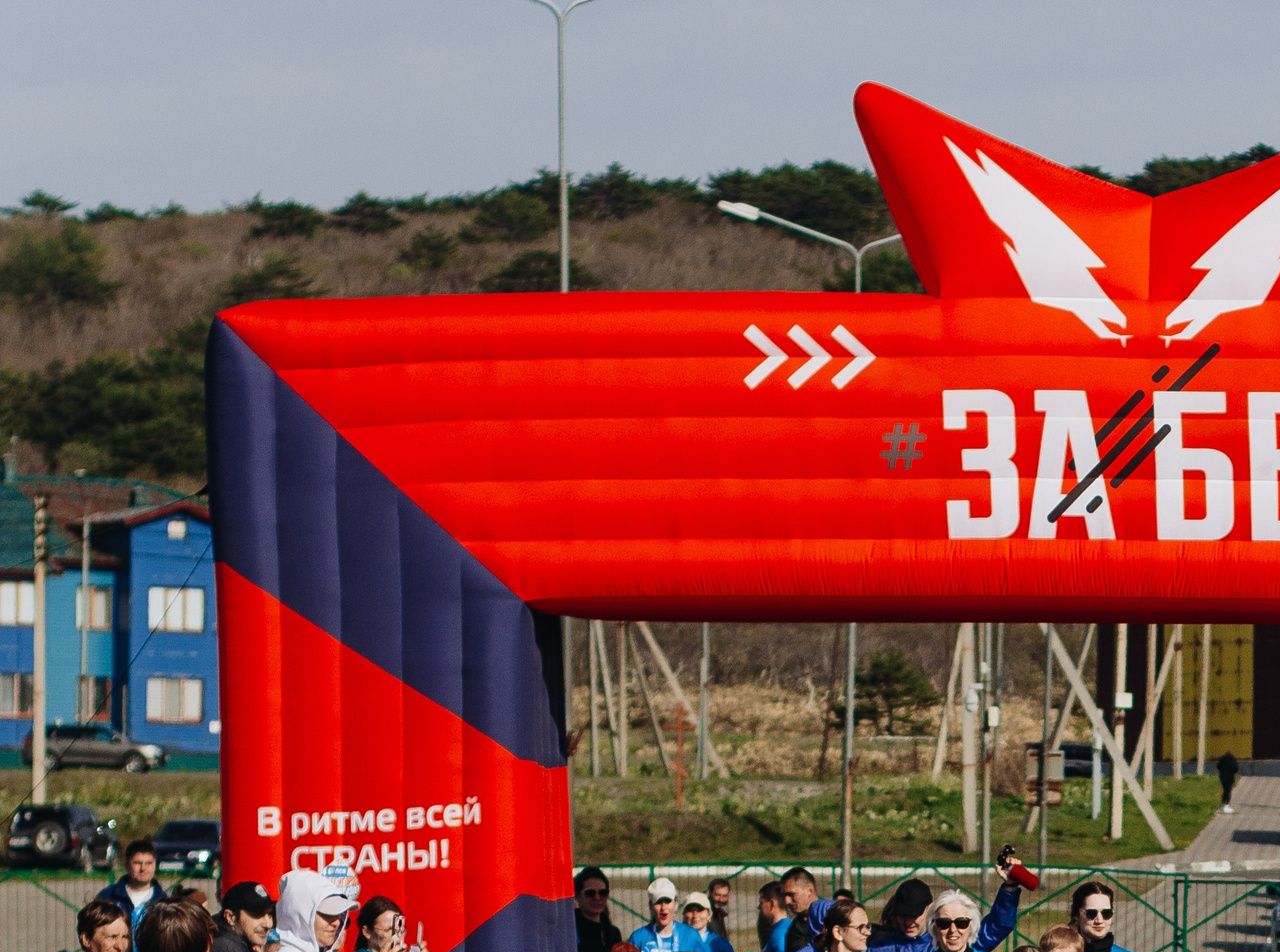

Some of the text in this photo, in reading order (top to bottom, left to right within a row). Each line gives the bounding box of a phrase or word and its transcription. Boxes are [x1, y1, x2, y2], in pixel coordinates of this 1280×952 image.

[257, 796, 482, 840] В ритме всей
[290, 838, 450, 875] СТРАНЫ!
